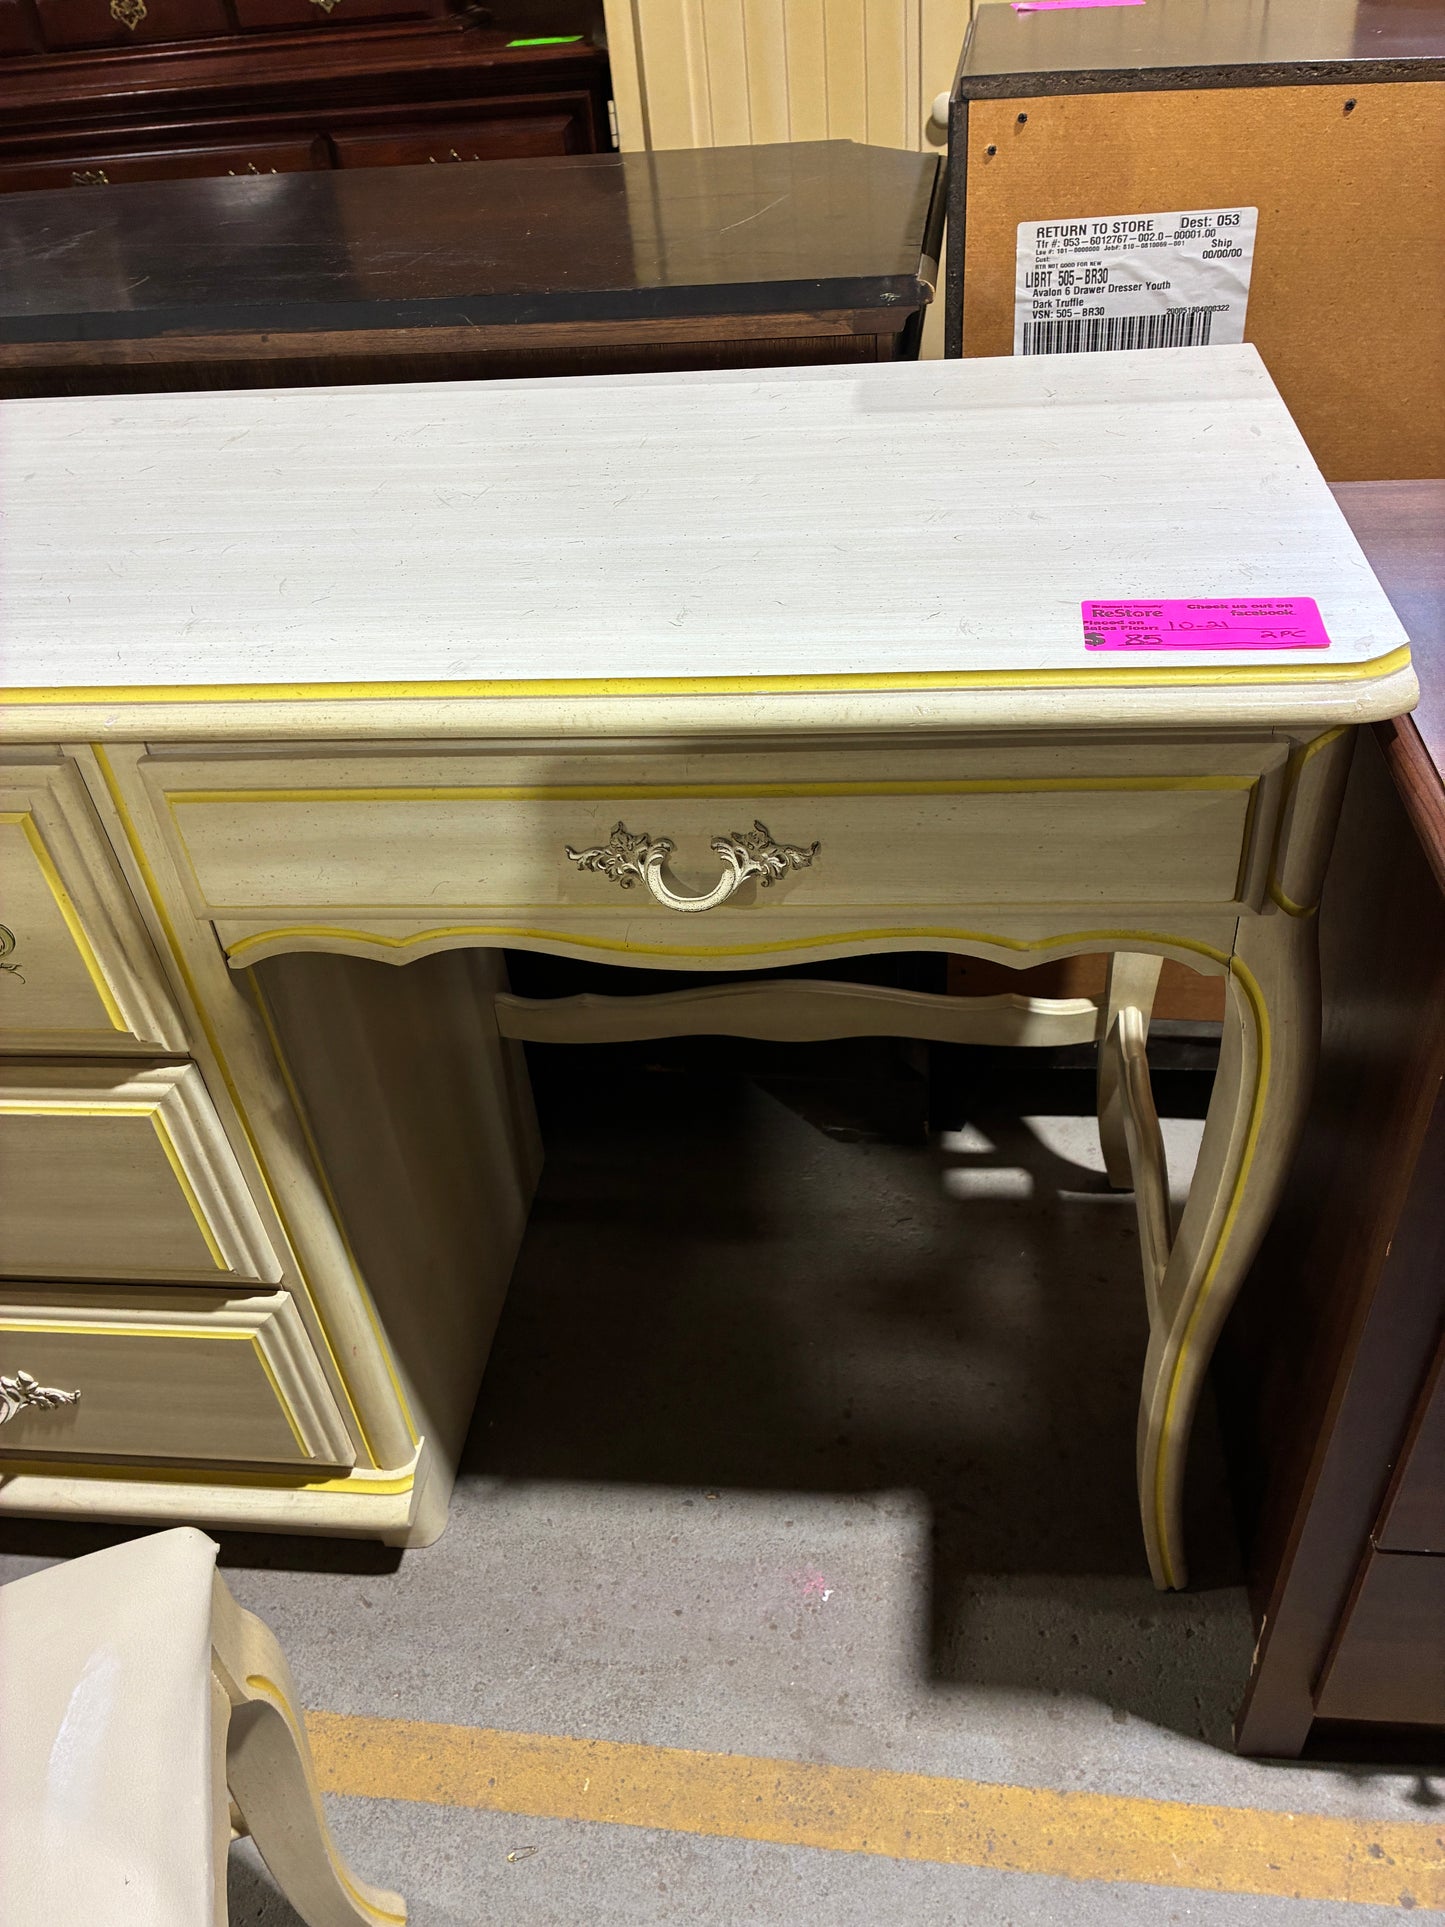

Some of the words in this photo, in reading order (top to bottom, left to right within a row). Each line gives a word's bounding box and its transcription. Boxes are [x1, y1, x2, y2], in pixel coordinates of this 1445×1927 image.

[1181, 216, 1212, 228] Dest:
[1216, 214, 1240, 226] 053
[1036, 224, 1087, 238] RETURN
[1092, 223, 1108, 234] TO
[1112, 220, 1154, 234] STORE
[1211, 238, 1232, 248] Ship
[1202, 248, 1242, 260] 00/00/00
[1025, 271, 1052, 288] LIBRT
[1032, 288, 1062, 298] Avalon
[1065, 286, 1071, 296] 6
[1074, 286, 1105, 295] Drawer
[1108, 283, 1142, 293] Dresser
[1146, 280, 1171, 290] Youth
[1032, 300, 1052, 309] Dark
[1056, 298, 1084, 308] Truffle
[1032, 310, 1054, 319] VSN:
[1092, 609, 1164, 618] ReStore
[1168, 620, 1229, 631] 10-21
[1084, 632, 1106, 646] $
[1125, 634, 1164, 646] 85
